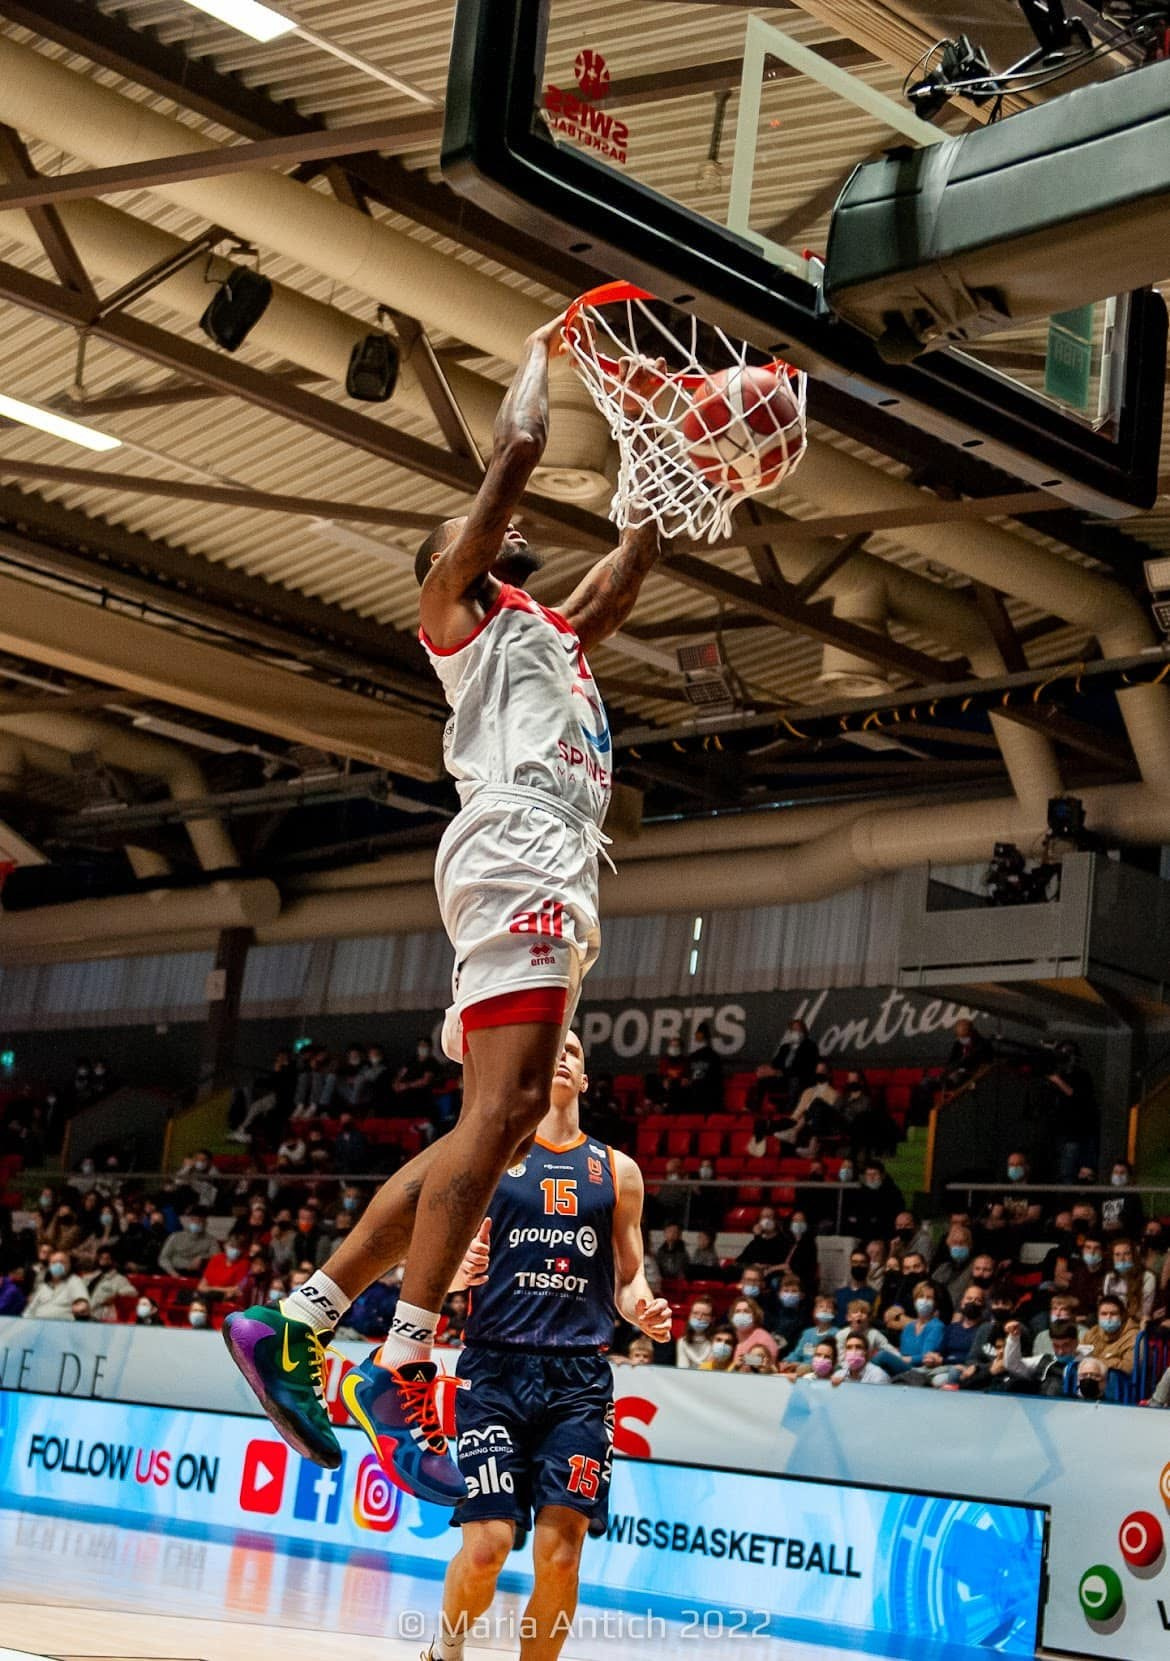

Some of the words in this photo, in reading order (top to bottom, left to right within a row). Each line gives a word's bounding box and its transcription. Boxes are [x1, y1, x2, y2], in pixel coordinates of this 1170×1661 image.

[558, 739, 614, 790] SPINE
[509, 899, 564, 939] ail
[571, 1004, 747, 1057] PORTS
[540, 1178, 578, 1216] 15
[509, 1228, 575, 1249] groupe
[514, 1272, 589, 1294] TISSOT
[55, 1352, 107, 1398] DE
[27, 1434, 134, 1481] FOLLOW
[134, 1448, 172, 1487] US
[175, 1453, 220, 1493] ON
[567, 1454, 601, 1501] 15
[588, 1513, 862, 1579] WISSBASKETBALL
